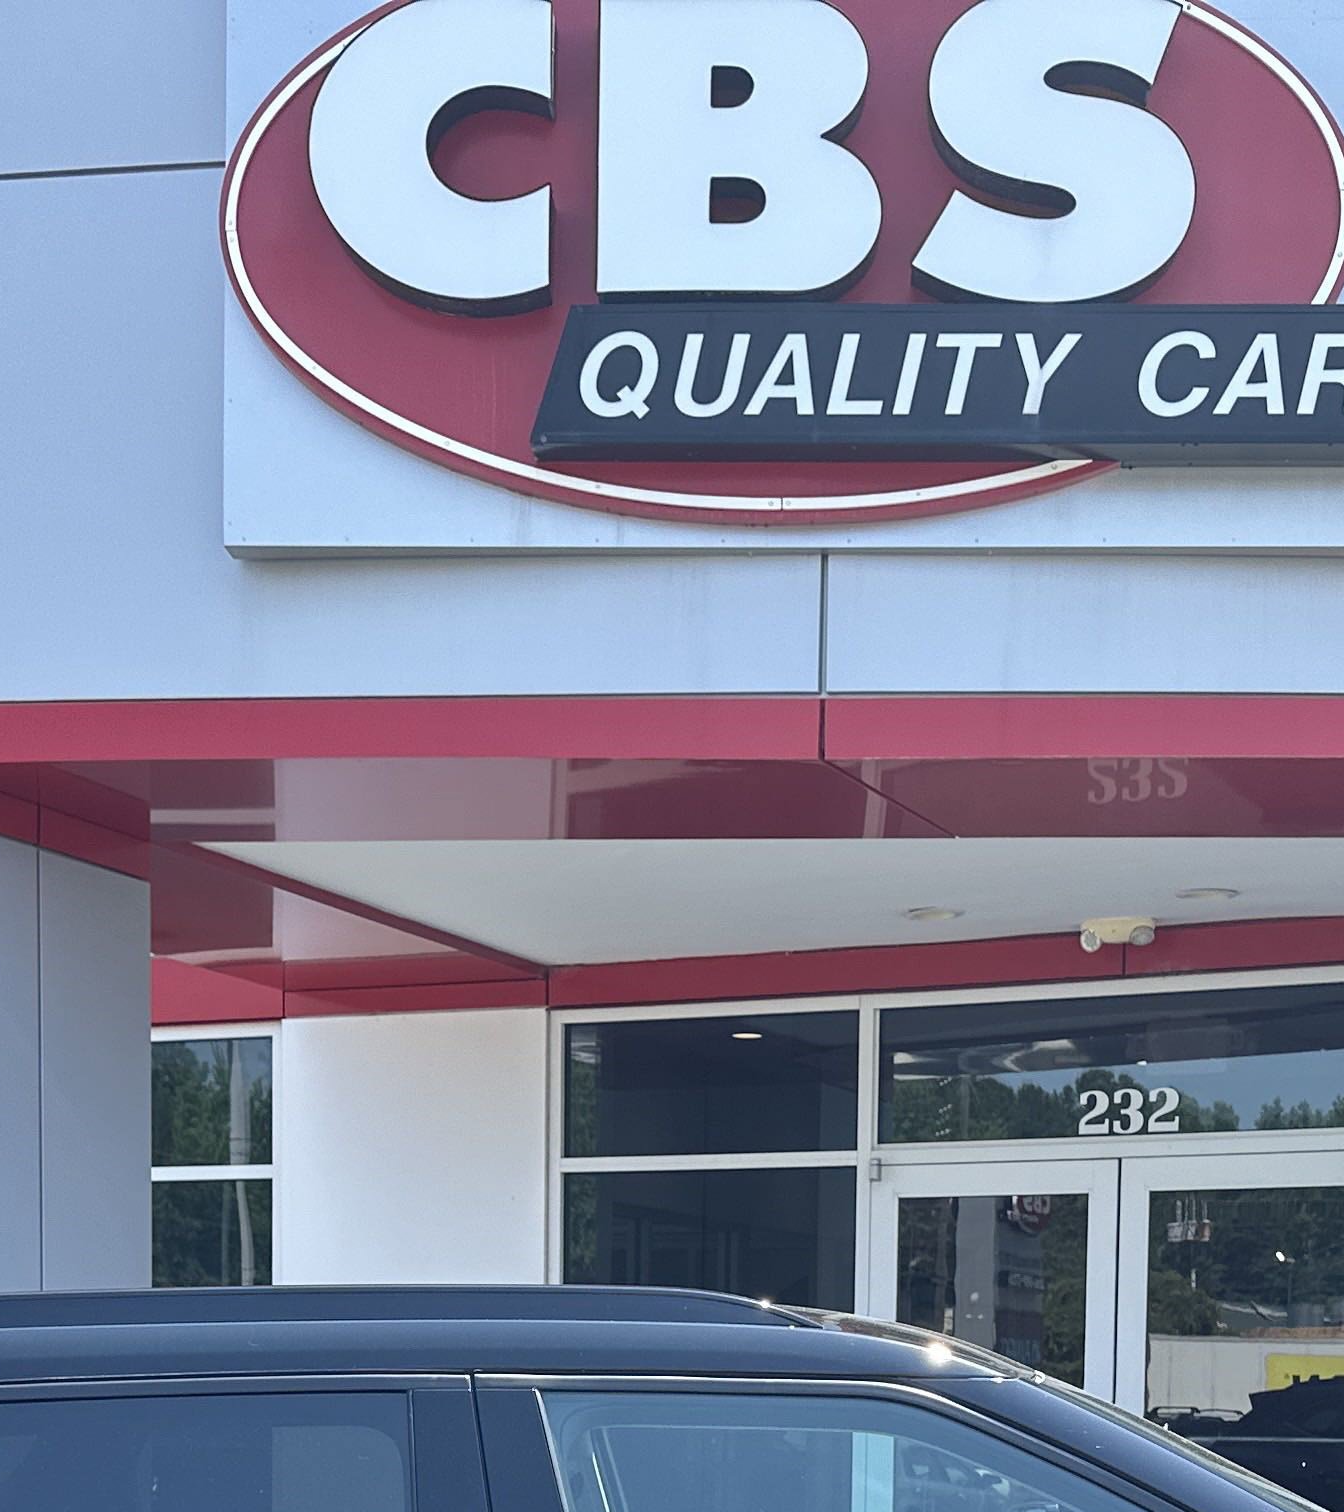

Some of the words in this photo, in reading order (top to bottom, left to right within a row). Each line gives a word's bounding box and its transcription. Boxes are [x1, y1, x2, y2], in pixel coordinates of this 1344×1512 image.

[308, 0, 1197, 306] CBS
[578, 330, 1084, 420] QUALITY
[1078, 1087, 1180, 1135] 232
